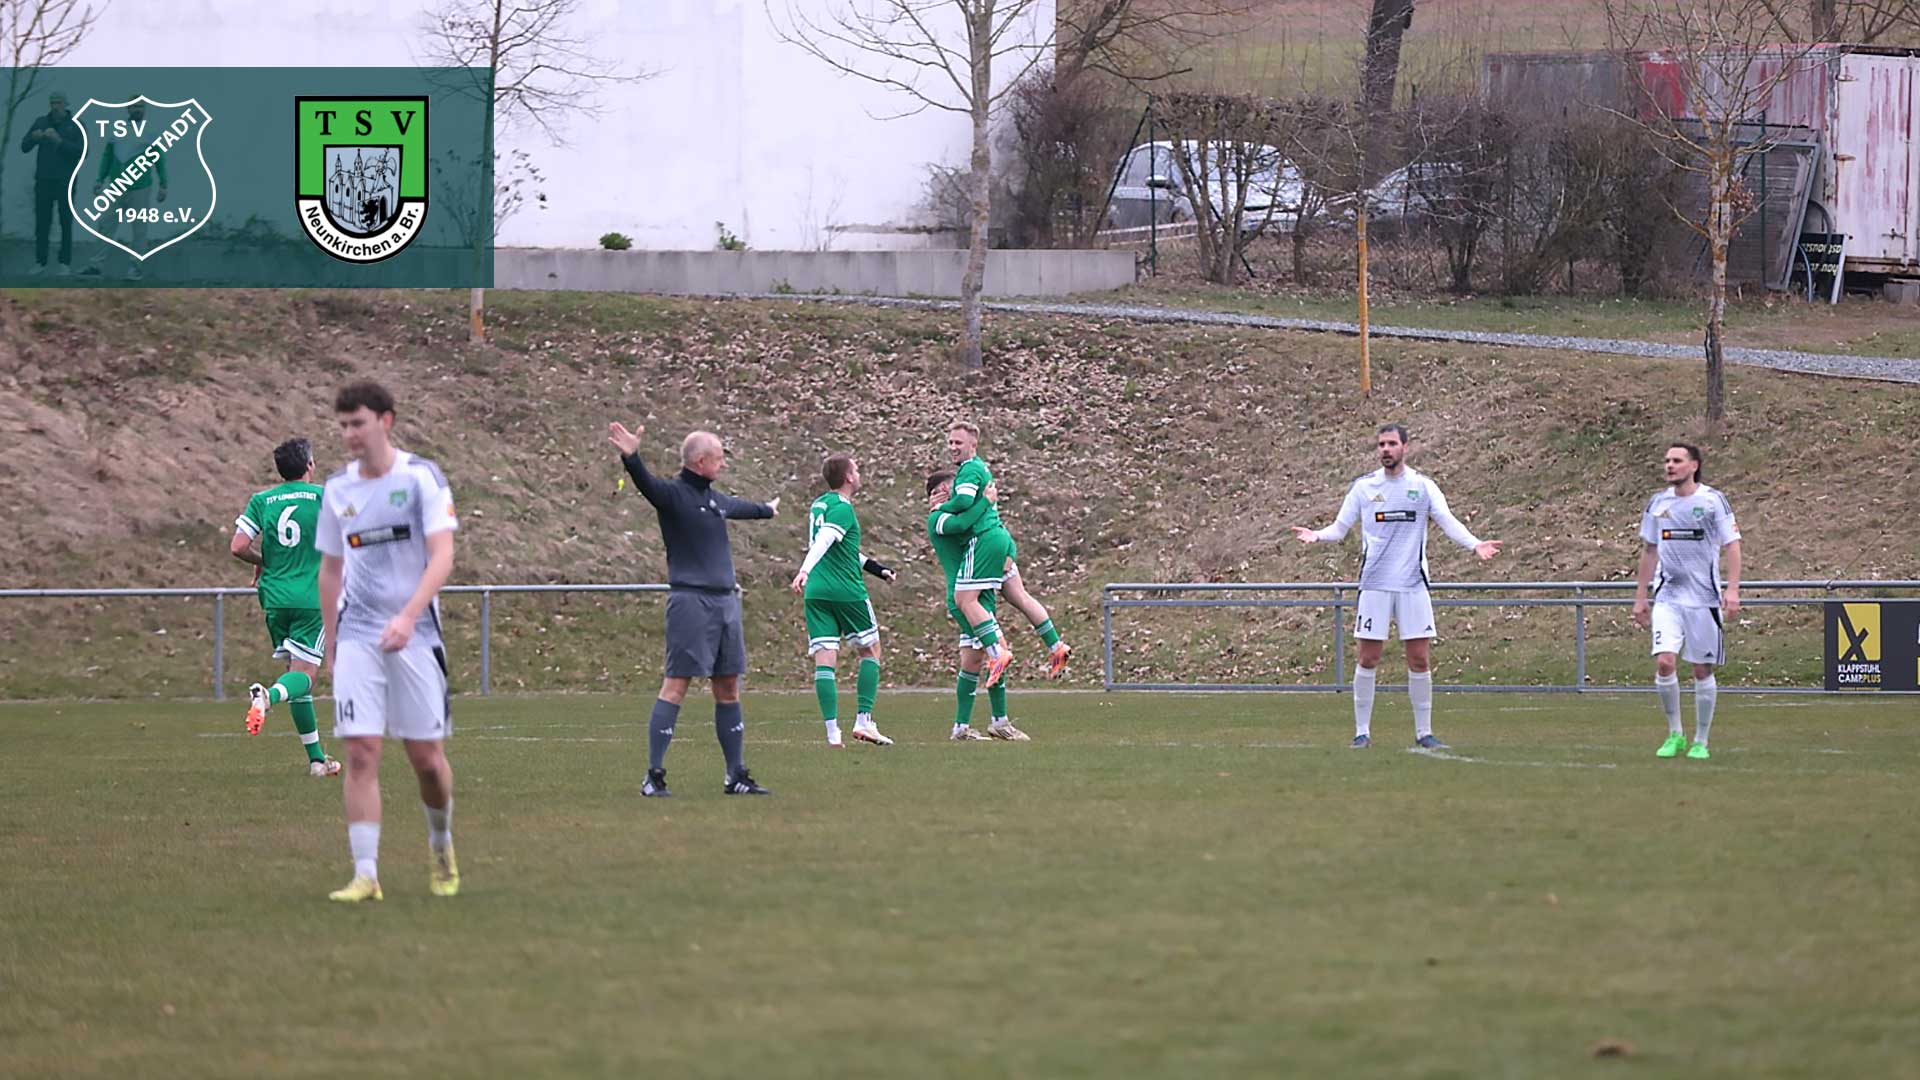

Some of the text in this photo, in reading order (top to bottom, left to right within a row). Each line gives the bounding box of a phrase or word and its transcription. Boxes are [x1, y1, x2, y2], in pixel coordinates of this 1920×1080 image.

[277, 505, 301, 548] 6
[1356, 614, 1372, 632] 14
[1655, 631, 1662, 645] 2
[1838, 664, 1881, 673] KLAPPSTUHL
[338, 699, 354, 722] 14
